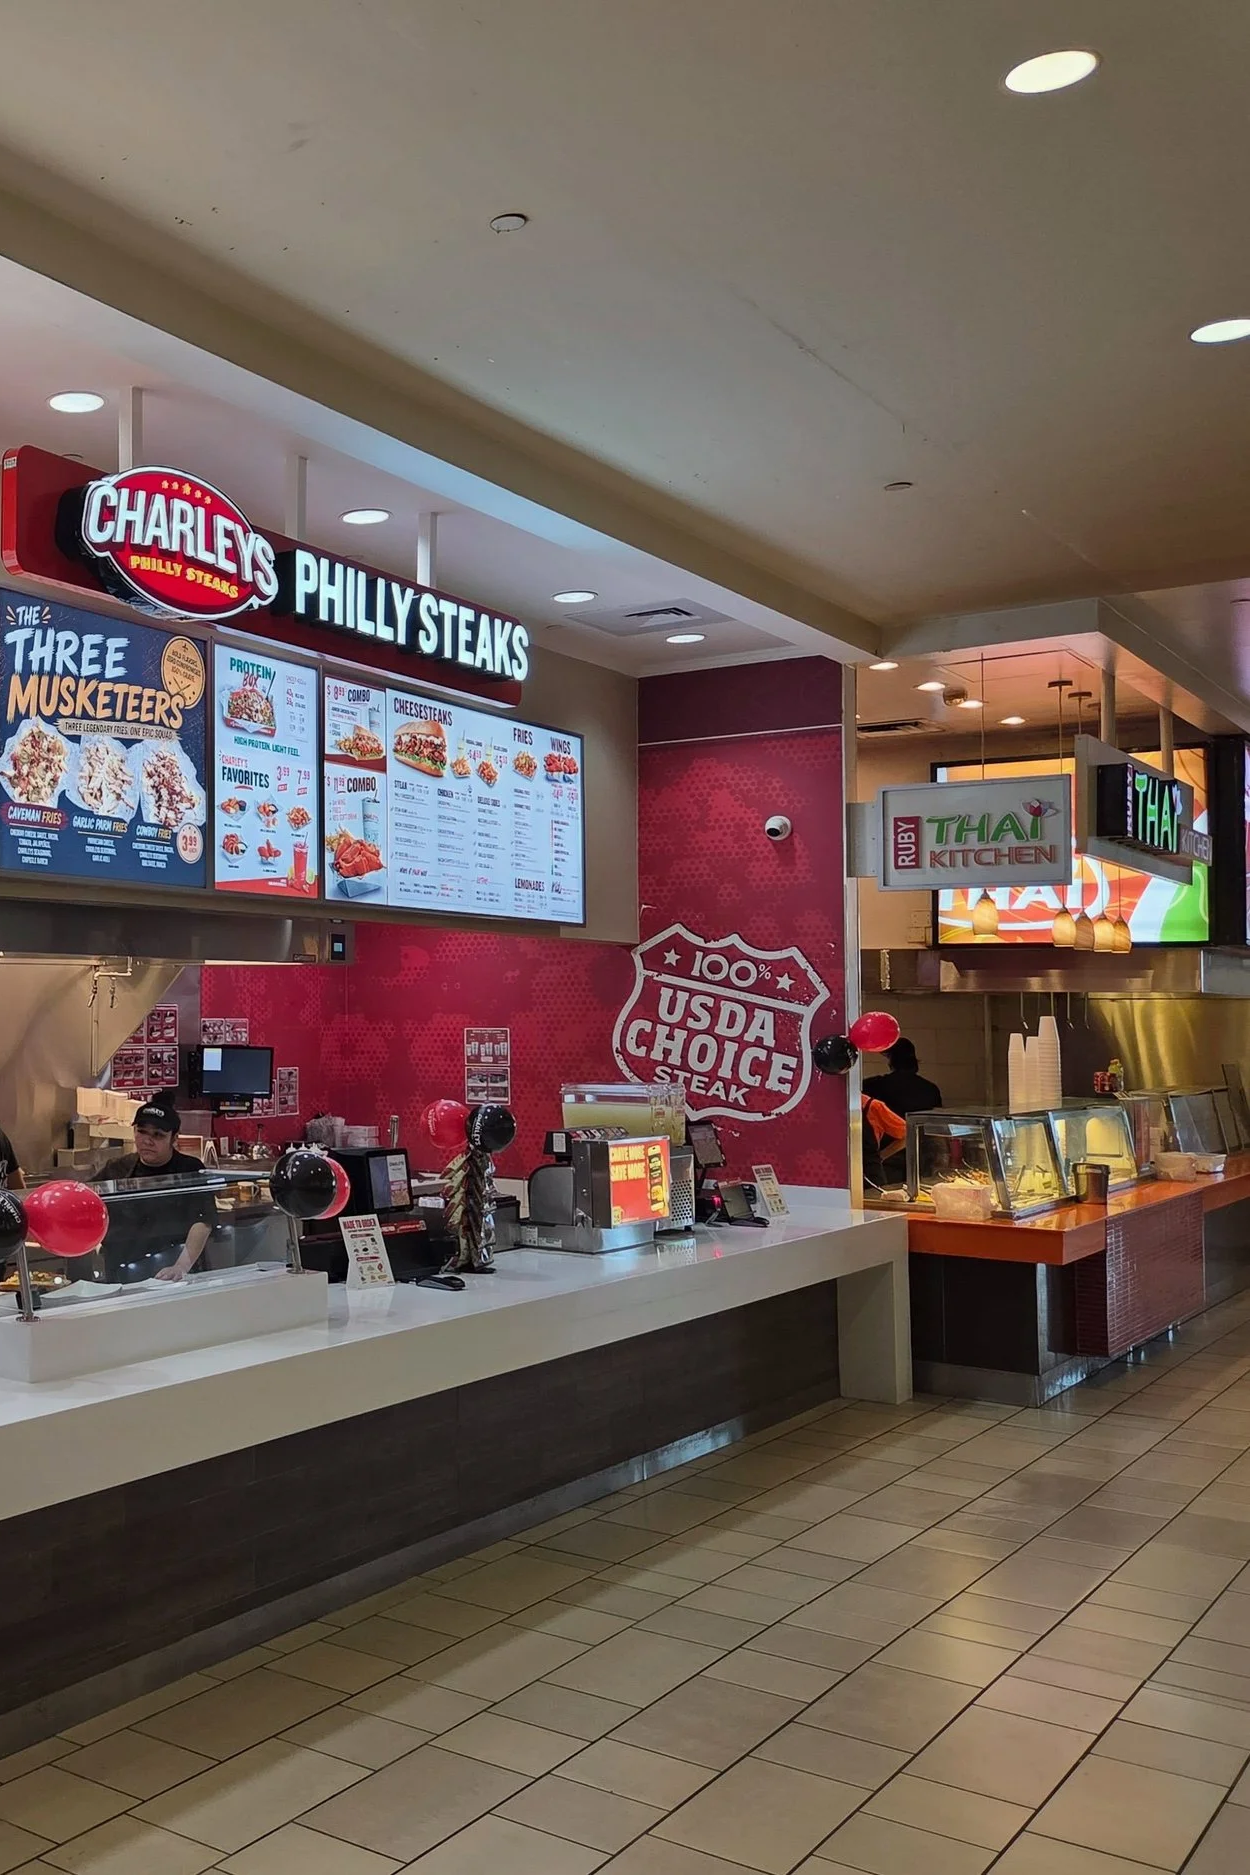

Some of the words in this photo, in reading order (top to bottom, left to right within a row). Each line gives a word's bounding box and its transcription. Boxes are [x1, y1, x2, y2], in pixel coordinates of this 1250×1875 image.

[85, 482, 279, 598] CHARLEYS
[130, 555, 182, 577] PHILLY
[186, 567, 239, 598] STEAKS
[17, 606, 40, 626] THE
[295, 548, 421, 647] PHILLY
[418, 591, 529, 682] STEAKS
[4, 627, 130, 679] THREE
[229, 657, 271, 680] PROTEIN
[243, 672, 258, 687] BOX
[7, 673, 185, 730] MUSKETEERS
[348, 689, 370, 702] COMBO
[394, 697, 452, 726] CHEESESTEAKS
[65, 721, 82, 731] THREE
[83, 722, 114, 734] LEGENDARY
[130, 727, 141, 736] ONE
[142, 728, 154, 737] EPIC
[513, 727, 533, 746] FRIES
[234, 735, 247, 745] HIGH
[273, 744, 287, 754] LIGHT
[550, 737, 571, 754] WINGS
[222, 766, 269, 788] FAVORITES
[347, 776, 376, 793] COMBO
[8, 806, 41, 822] CAVEMAN
[42, 810, 62, 825] FRIES
[73, 815, 94, 829] GARLIC
[95, 819, 111, 831] PARM
[113, 821, 128, 833] FRIES
[1135, 772, 1178, 853] THAI
[136, 825, 157, 837] COWBOY
[158, 828, 172, 839] FRIES
[926, 804, 1046, 845] THAI
[897, 820, 916, 867] RUBY
[929, 845, 1056, 868] KITCHEN
[515, 877, 544, 891] LEMONADES
[691, 951, 771, 987] 100%
[658, 987, 775, 1047] USDA
[625, 1019, 798, 1095] CHOICE
[653, 1065, 750, 1106] STEAK
